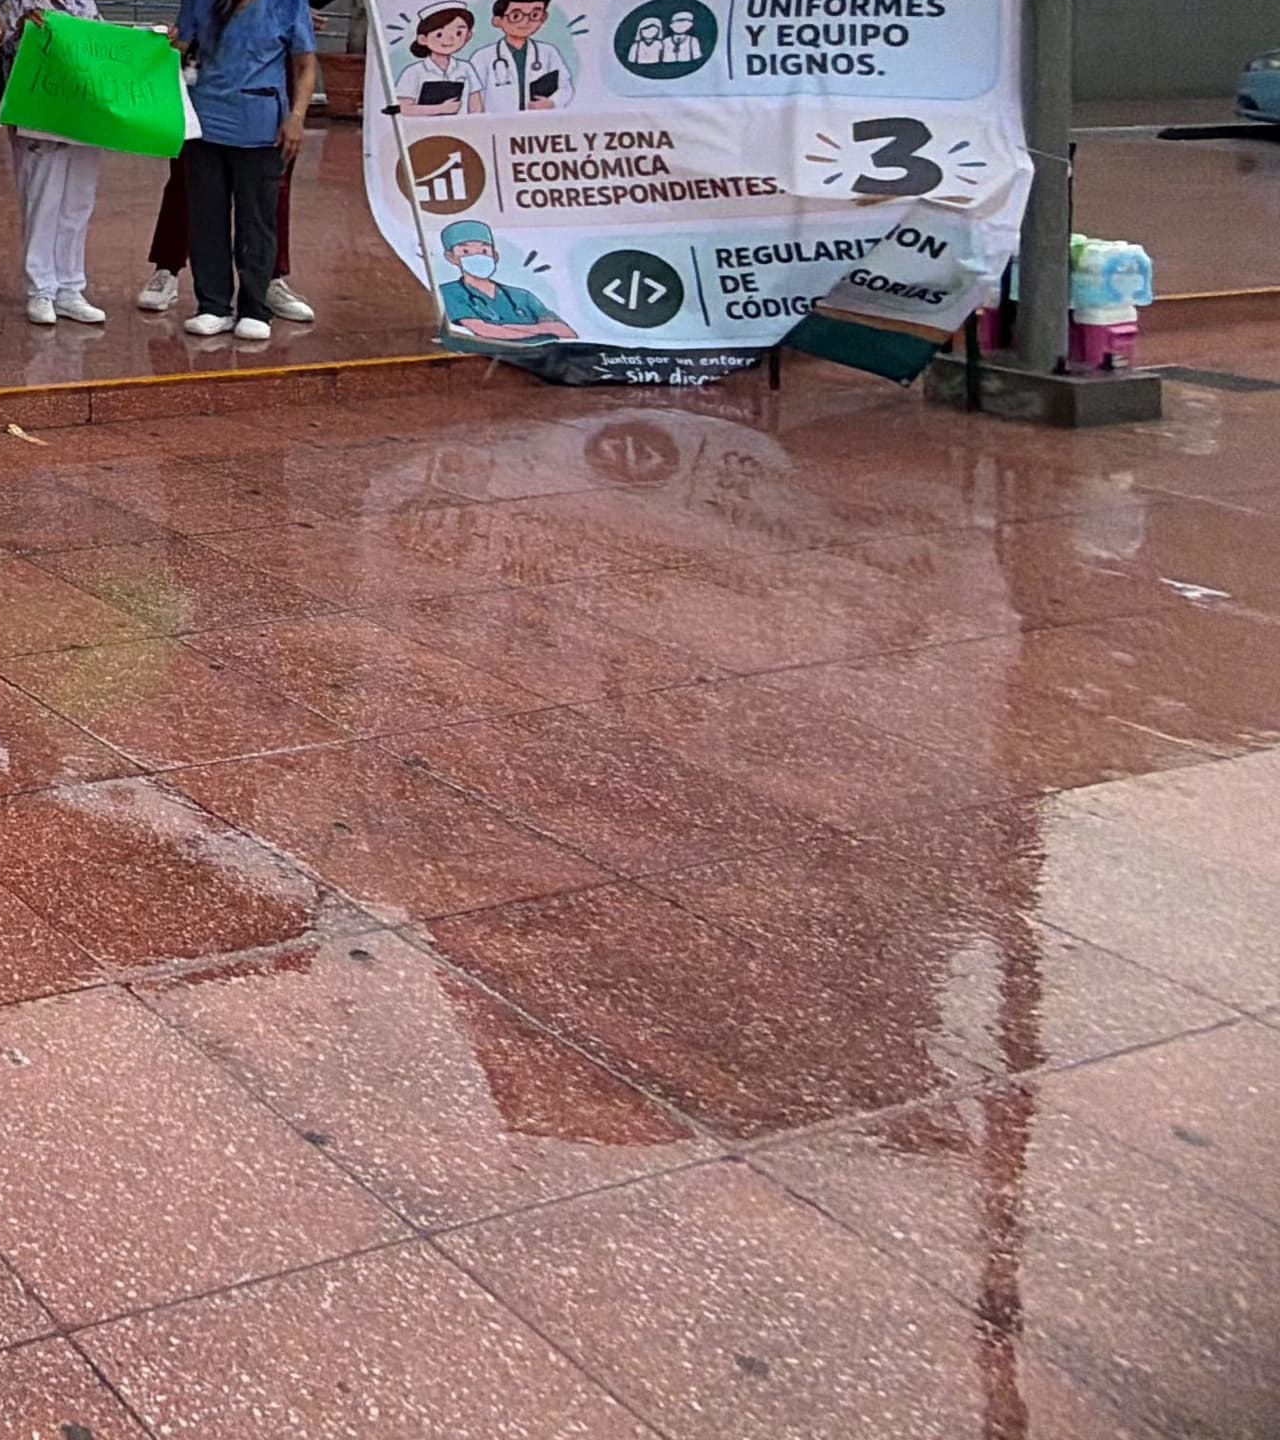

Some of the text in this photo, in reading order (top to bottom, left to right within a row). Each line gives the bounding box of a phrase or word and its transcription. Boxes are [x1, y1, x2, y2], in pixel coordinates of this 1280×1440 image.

[744, 23, 910, 50] Y EQUIPO
[745, 53, 887, 76] DIGNOS.
[509, 130, 675, 155] NIVEL Y ZONA
[511, 151, 670, 183] ECONÓMICA
[851, 117, 944, 197] 3
[514, 174, 787, 210] CORRESPONDIENTES.
[719, 272, 760, 294] DE
